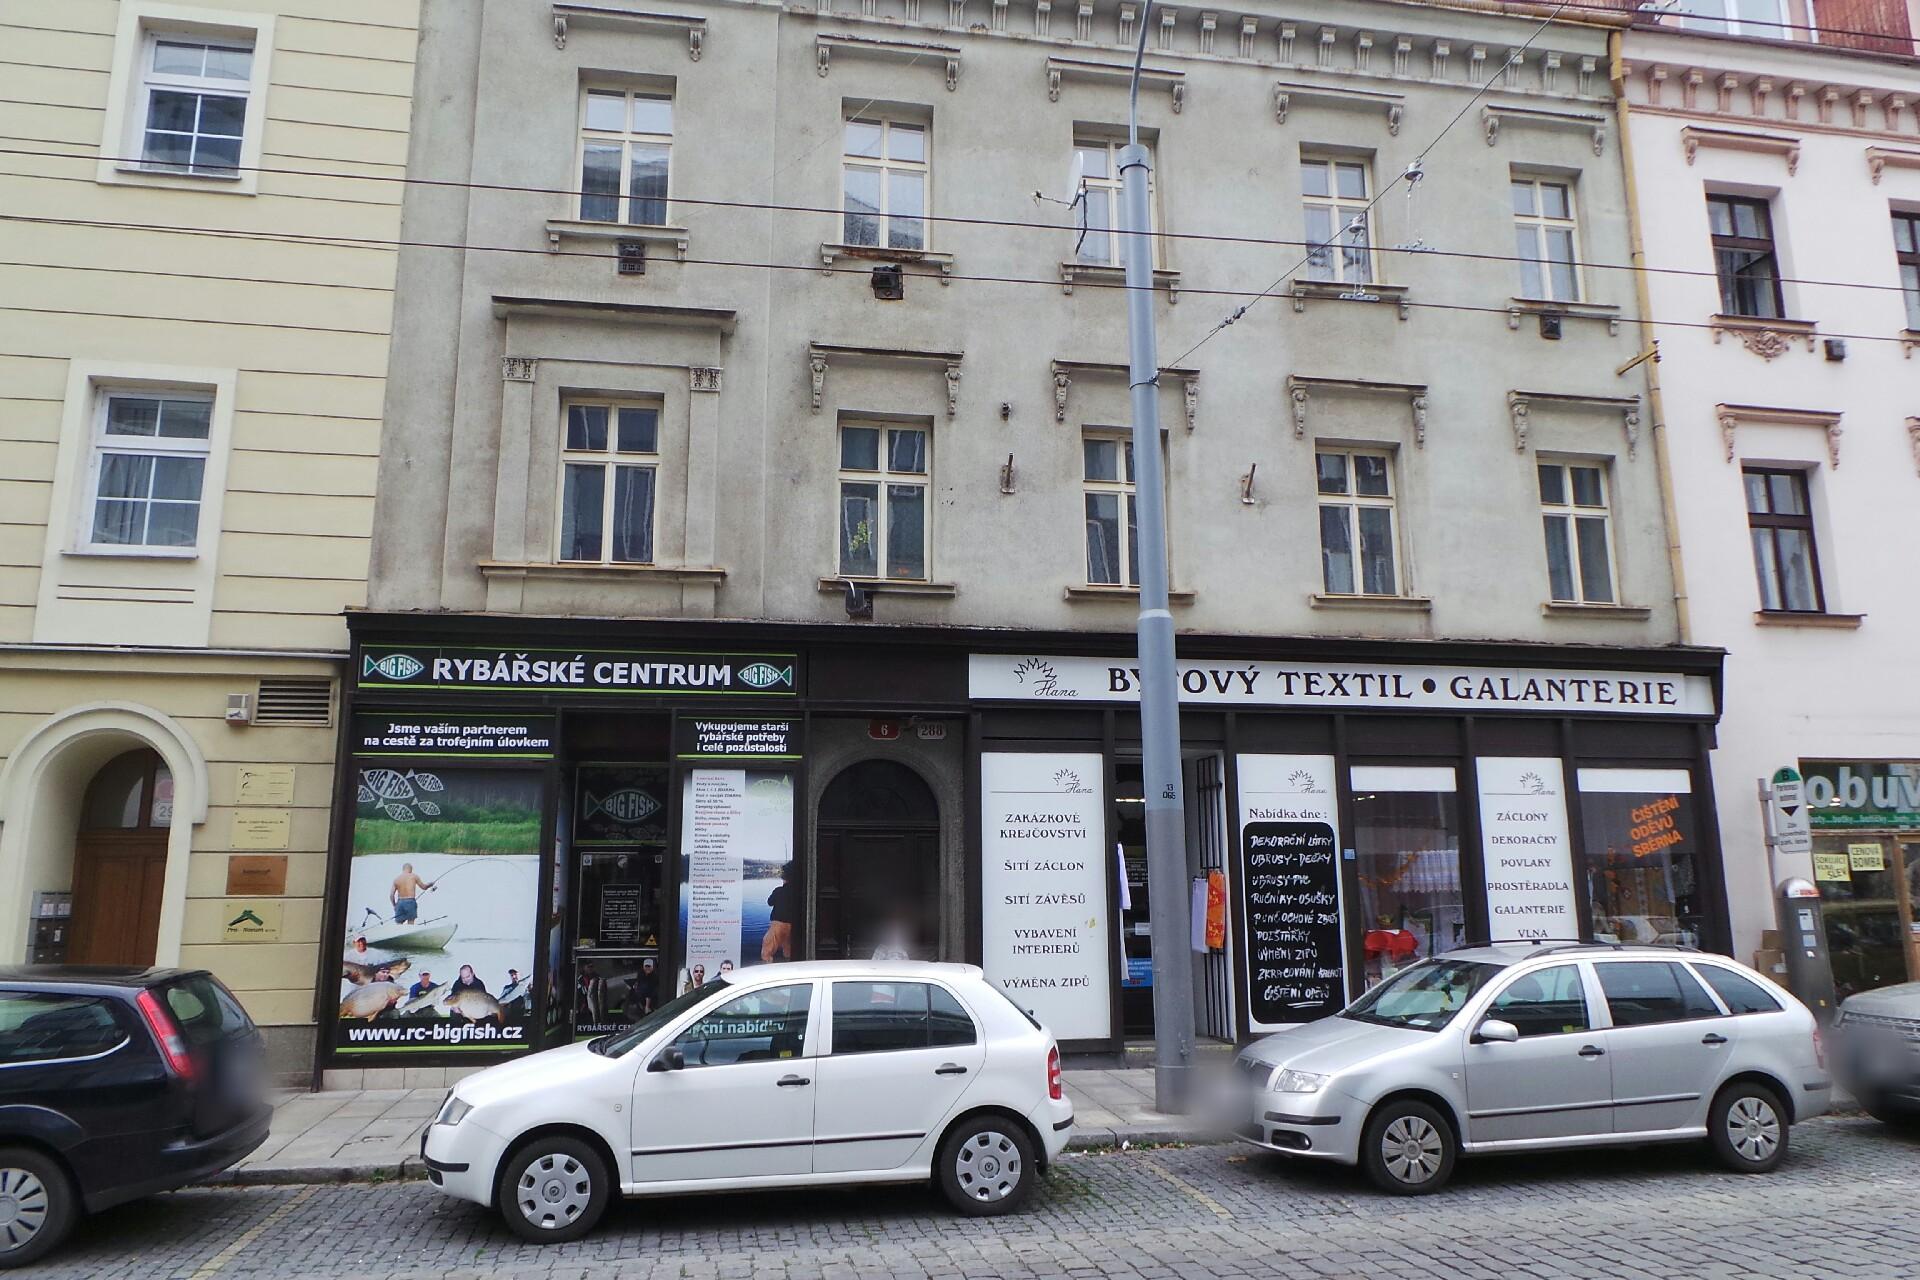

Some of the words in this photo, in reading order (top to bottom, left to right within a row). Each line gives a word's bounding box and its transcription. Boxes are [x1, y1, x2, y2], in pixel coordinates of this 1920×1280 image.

[379, 656, 396, 677] BIG
[398, 656, 418, 678] FISH
[432, 653, 585, 684] RYBÁŘSKÉ
[593, 662, 731, 686] CENTRUM
[743, 665, 758, 684] BIG
[759, 664, 779, 686] FISH
[1108, 664, 1261, 696] BOVÝ
[1276, 670, 1413, 699] TEXTIL
[1033, 680, 1079, 698] Hana
[1449, 674, 1678, 706] GALANTERIE
[387, 723, 421, 734] Jsme
[423, 722, 459, 735] vaším
[462, 724, 527, 737] partnerem
[695, 721, 758, 732] Vykupujeme
[760, 721, 789, 732] starší
[881, 724, 889, 736] 6
[921, 724, 943, 736] 288
[364, 736, 379, 746] na
[382, 734, 416, 747] cestě
[419, 737, 433, 747] za
[437, 736, 494, 749] trofejním
[497, 735, 549, 748] úlovkem
[698, 731, 743, 743] rybářské
[746, 732, 785, 744] potřeby
[696, 742, 700, 751] i
[702, 741, 724, 752] celé
[725, 741, 787, 754] pozůstalosti
[605, 794, 625, 819] BIG
[627, 793, 655, 819] FISH
[1005, 811, 1081, 823] ZAKÁZKOVÉ
[1249, 807, 1298, 819] Nabídka
[1496, 811, 1549, 822] ZÁCLONY
[1000, 827, 1087, 839] KREJČOVSTVÍ
[1491, 834, 1558, 845] DEKORAČKY
[1251, 832, 1306, 848] DEKORAČNÍ
[1004, 859, 1029, 871] ŠITÍ
[1034, 859, 1084, 871] ZÁCLON
[1501, 858, 1551, 868] POVLAKY
[1487, 879, 1570, 891] PROSTĚRADLA
[1035, 892, 1086, 905] ZÁVĚSŮ
[1494, 905, 1566, 915] GALANTERIE
[1014, 926, 1077, 938] VYBAVENÍ
[1518, 928, 1549, 938] VLNA
[1012, 941, 1080, 954] INTERIERŮ
[1003, 976, 1057, 988] VÝMĚNA
[1061, 974, 1090, 987] ZIPŮ
[348, 1023, 523, 1043] www.rc-bigfish.cz
